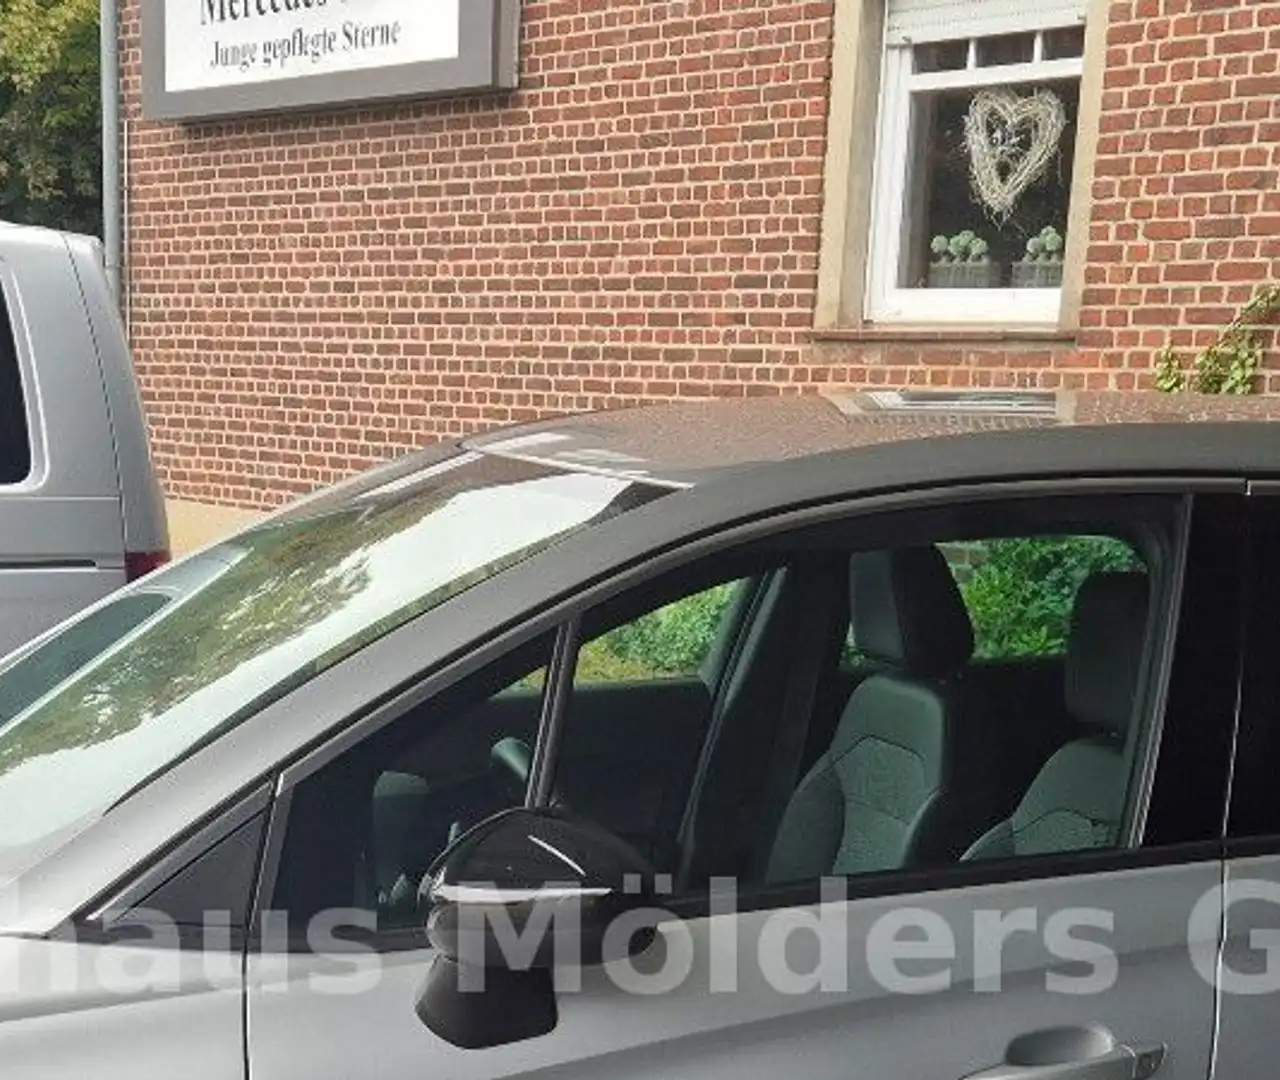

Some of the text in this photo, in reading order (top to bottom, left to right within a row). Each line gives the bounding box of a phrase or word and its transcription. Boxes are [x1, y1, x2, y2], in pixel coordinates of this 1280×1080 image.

[210, 20, 402, 71] Junge gepflegte Sterne
